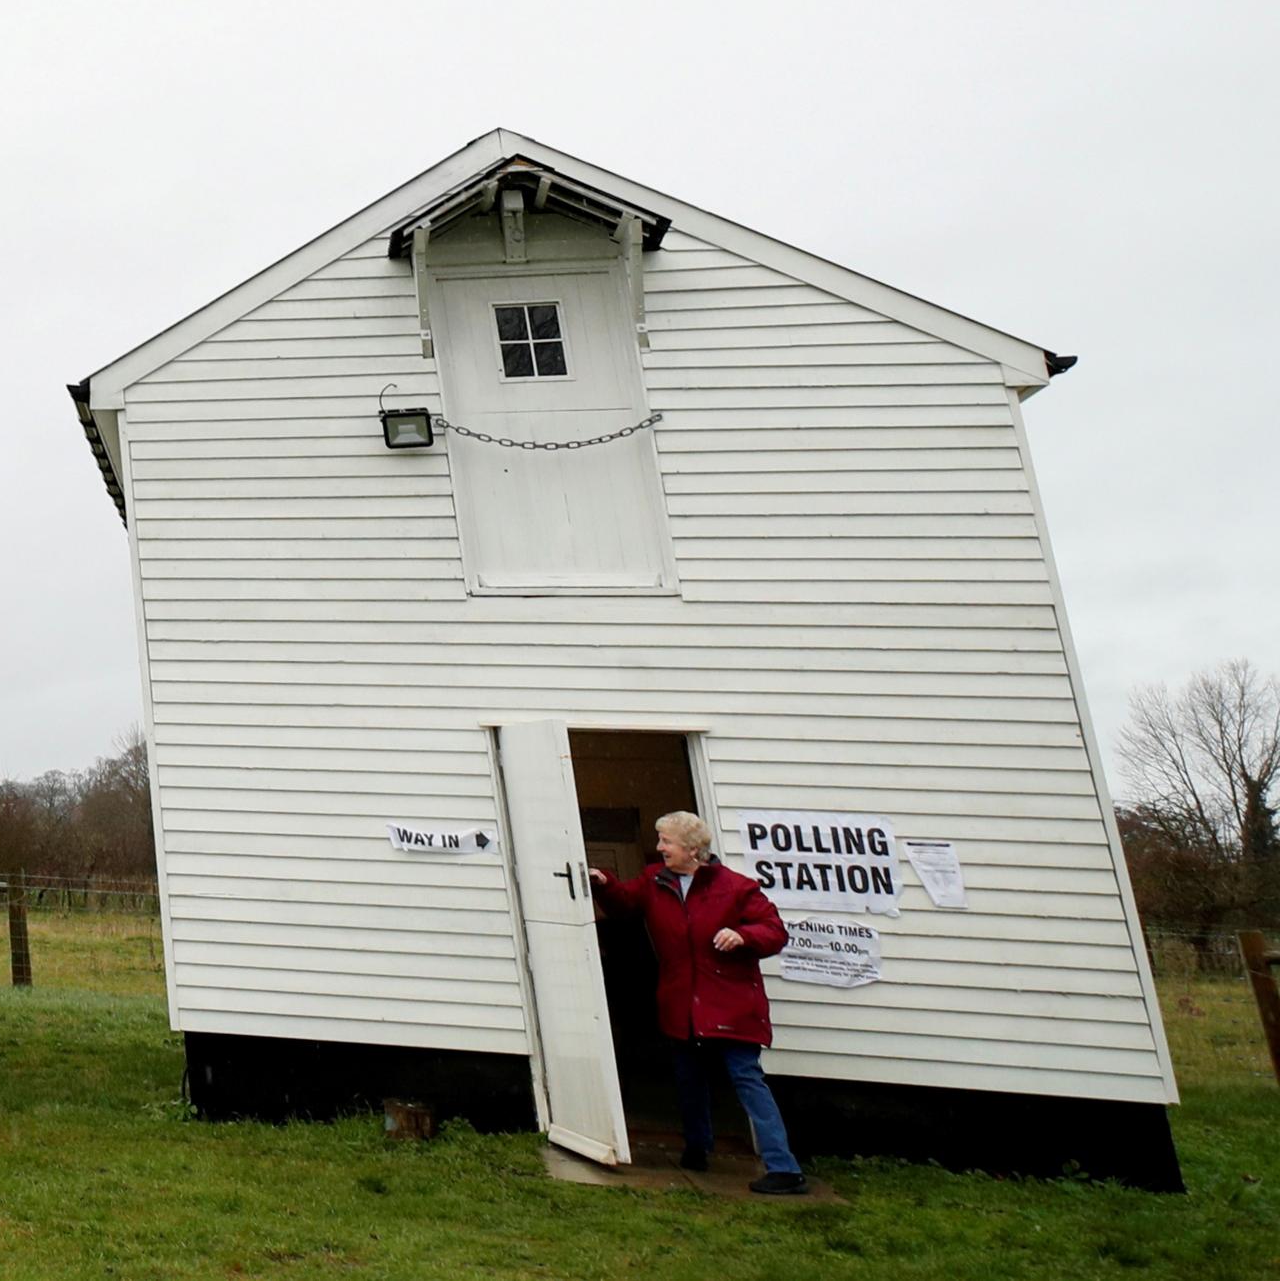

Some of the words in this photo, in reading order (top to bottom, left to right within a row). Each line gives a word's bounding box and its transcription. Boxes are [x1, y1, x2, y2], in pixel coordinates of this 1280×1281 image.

[396, 827, 434, 847] WAY
[441, 834, 460, 848] IN
[746, 822, 890, 856] POLLING
[755, 860, 894, 895] STATION
[836, 925, 873, 939] TIMES
